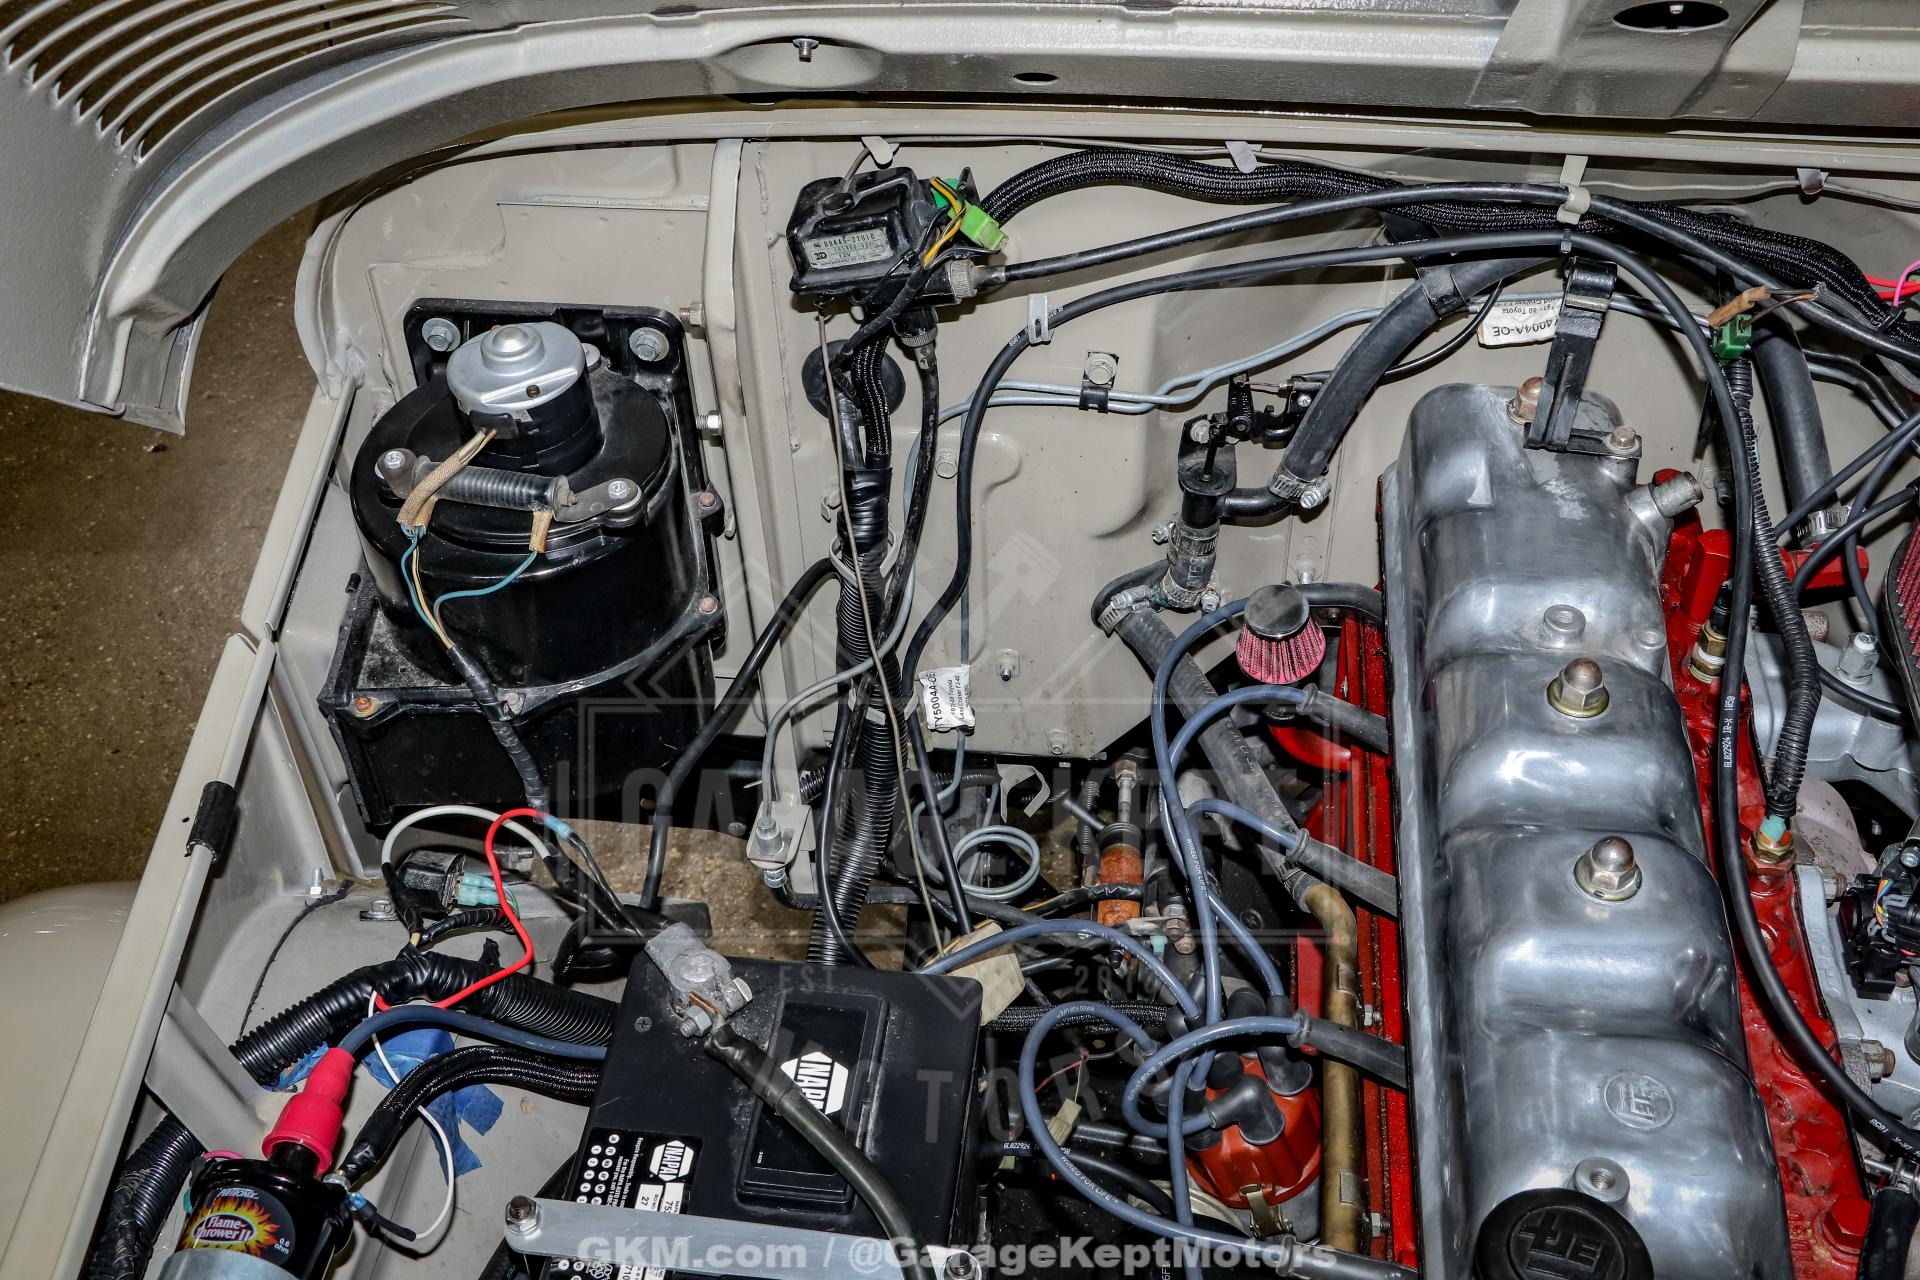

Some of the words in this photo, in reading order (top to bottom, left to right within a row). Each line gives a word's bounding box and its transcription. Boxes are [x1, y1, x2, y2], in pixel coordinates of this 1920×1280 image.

[1722, 718, 1733, 733] IR-X
[659, 1147, 685, 1176] NAPA
[1061, 1156, 1081, 1176] WIRED
[1080, 1176, 1095, 1190] FOR
[641, 1196, 649, 1206] 27
[279, 1238, 290, 1247] 0.6
[275, 1244, 289, 1254] ohm
